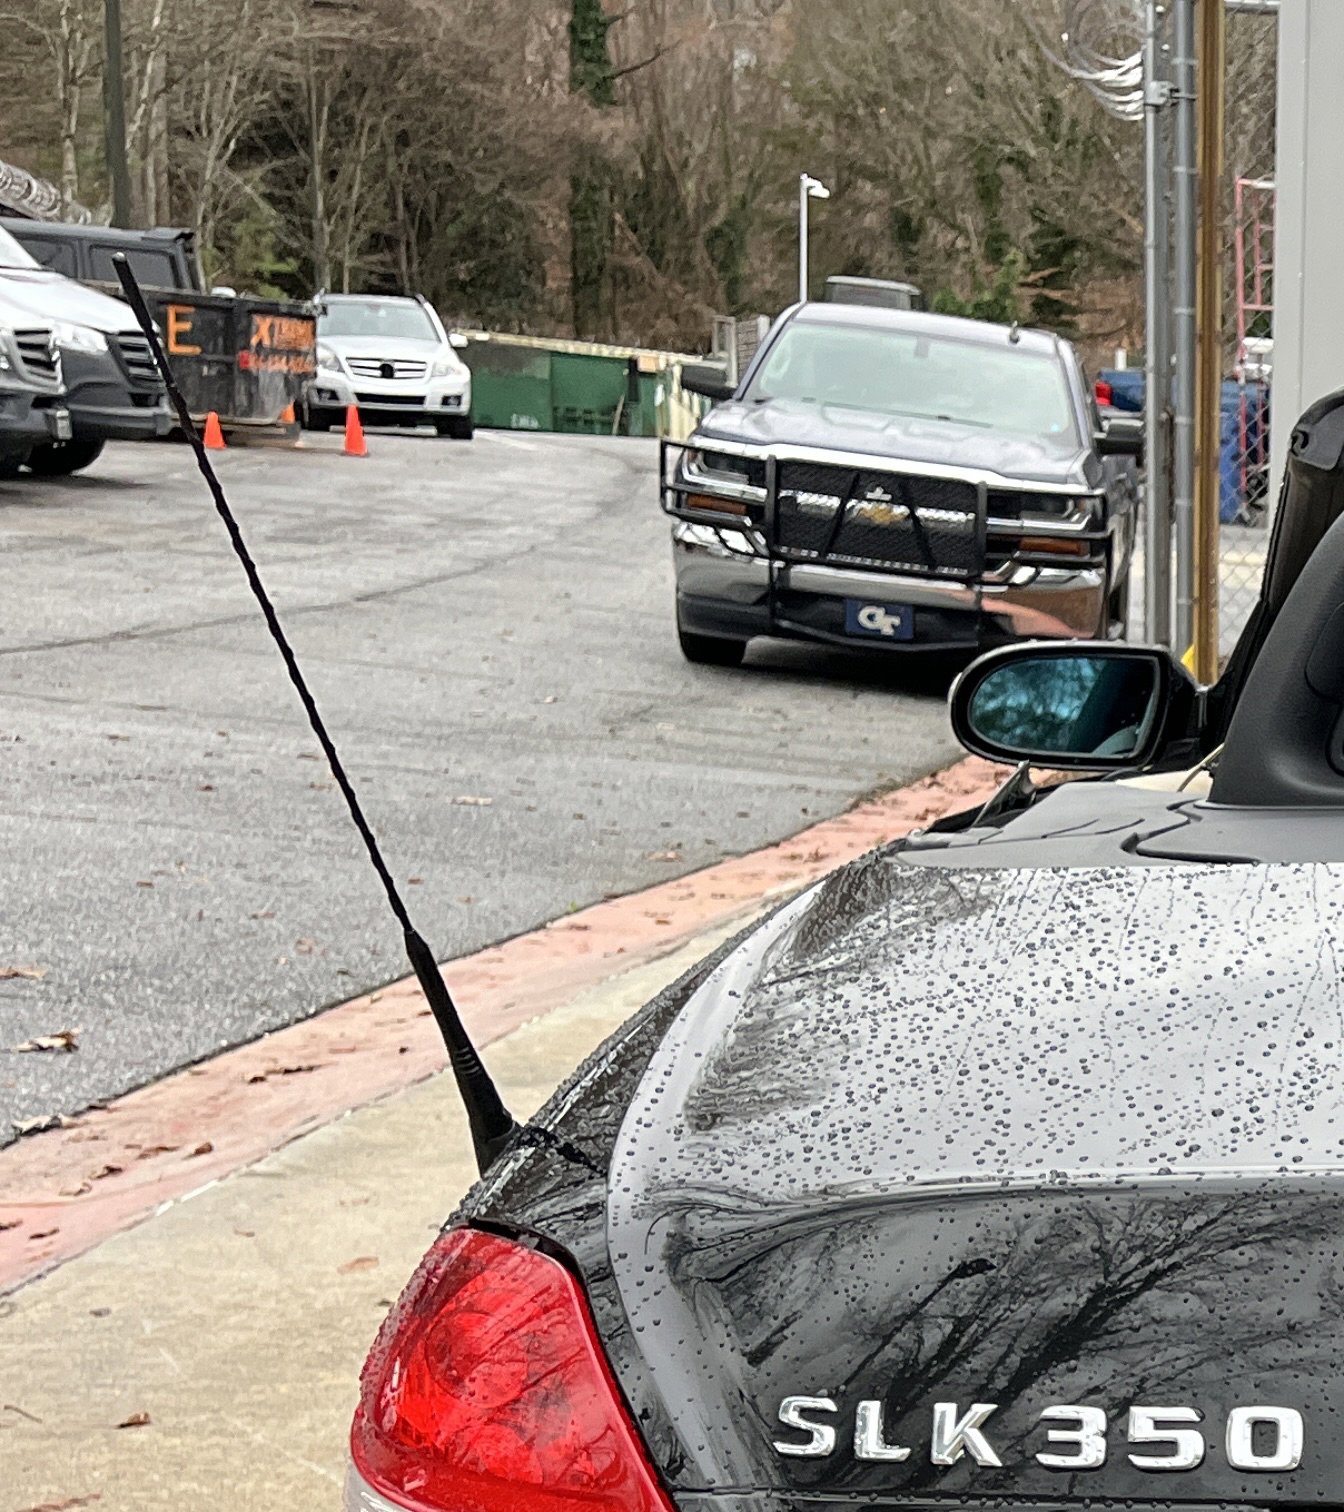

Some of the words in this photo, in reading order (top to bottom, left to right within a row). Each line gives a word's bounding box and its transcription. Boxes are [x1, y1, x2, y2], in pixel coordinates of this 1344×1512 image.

[167, 304, 202, 355] E
[773, 1396, 1002, 1468] SLK
[1035, 1405, 1304, 1472] 350
